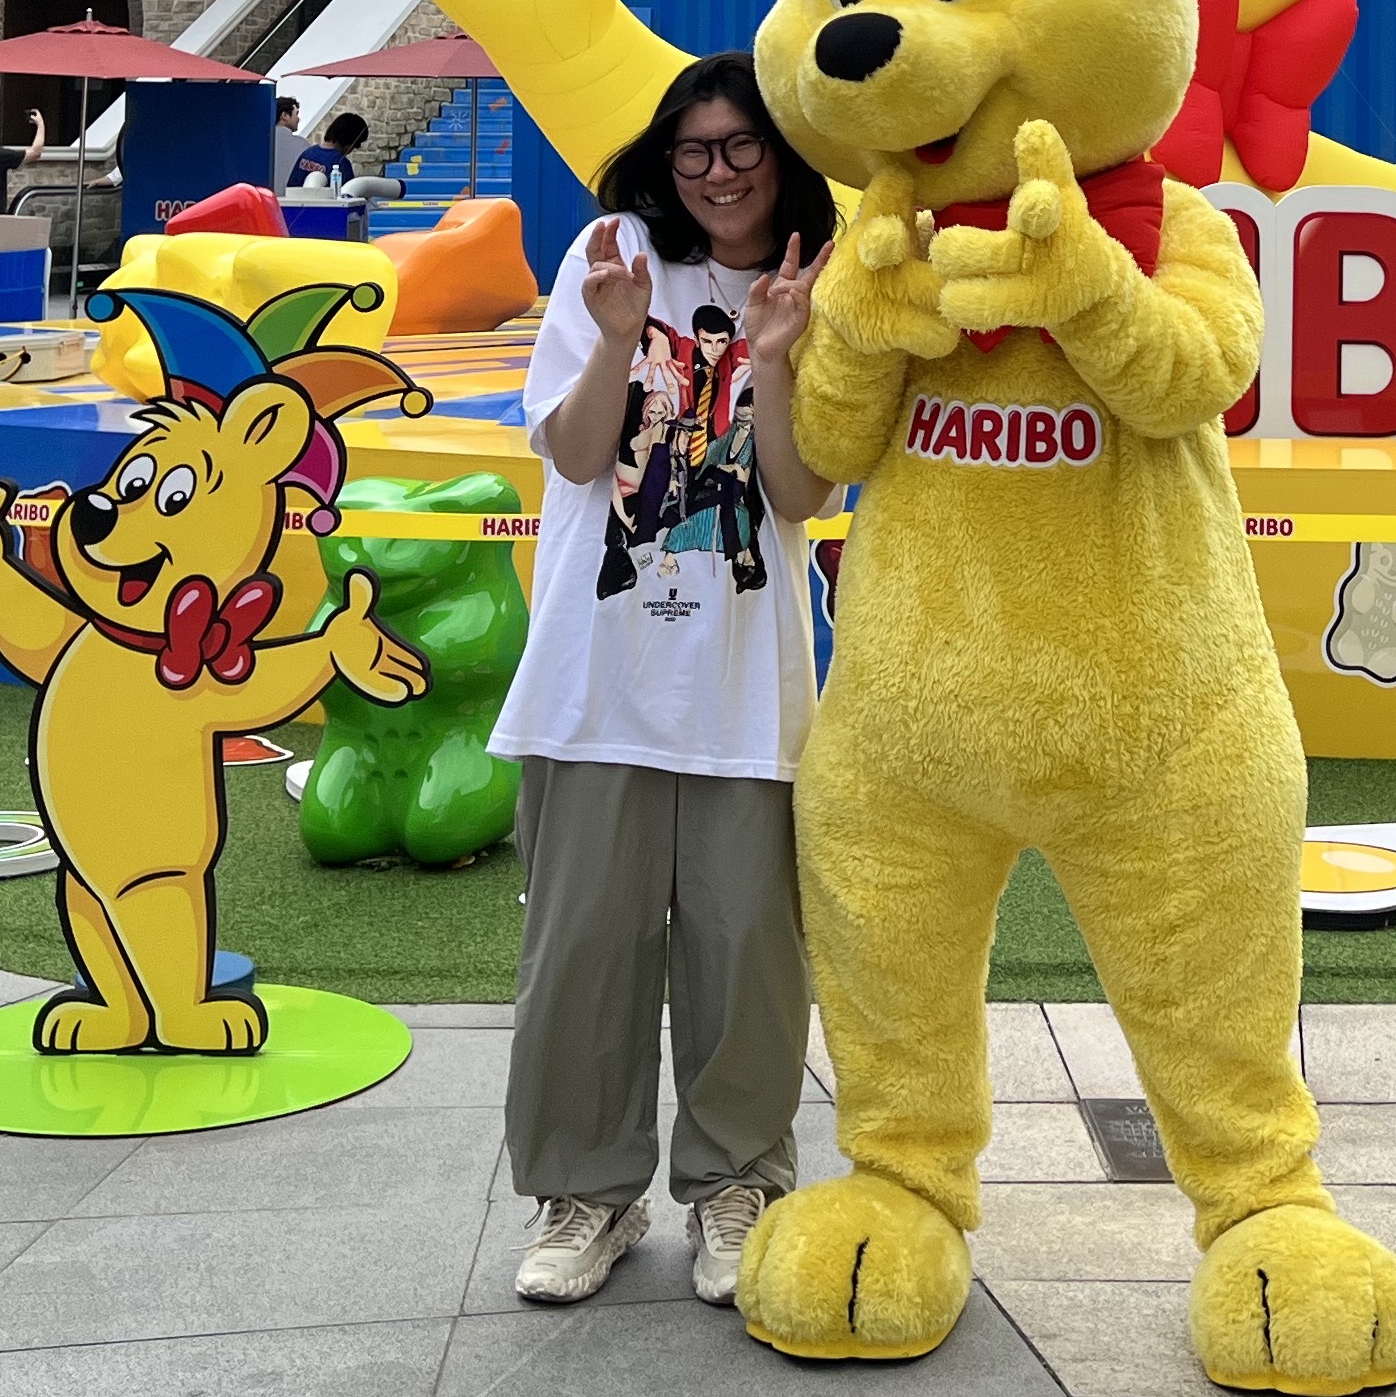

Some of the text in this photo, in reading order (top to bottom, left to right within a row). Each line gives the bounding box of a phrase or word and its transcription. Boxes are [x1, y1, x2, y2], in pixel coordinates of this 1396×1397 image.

[905, 396, 1099, 465] HARIBO
[1246, 517, 1294, 537] RIBO
[642, 601, 701, 610] UNDERCOVER
